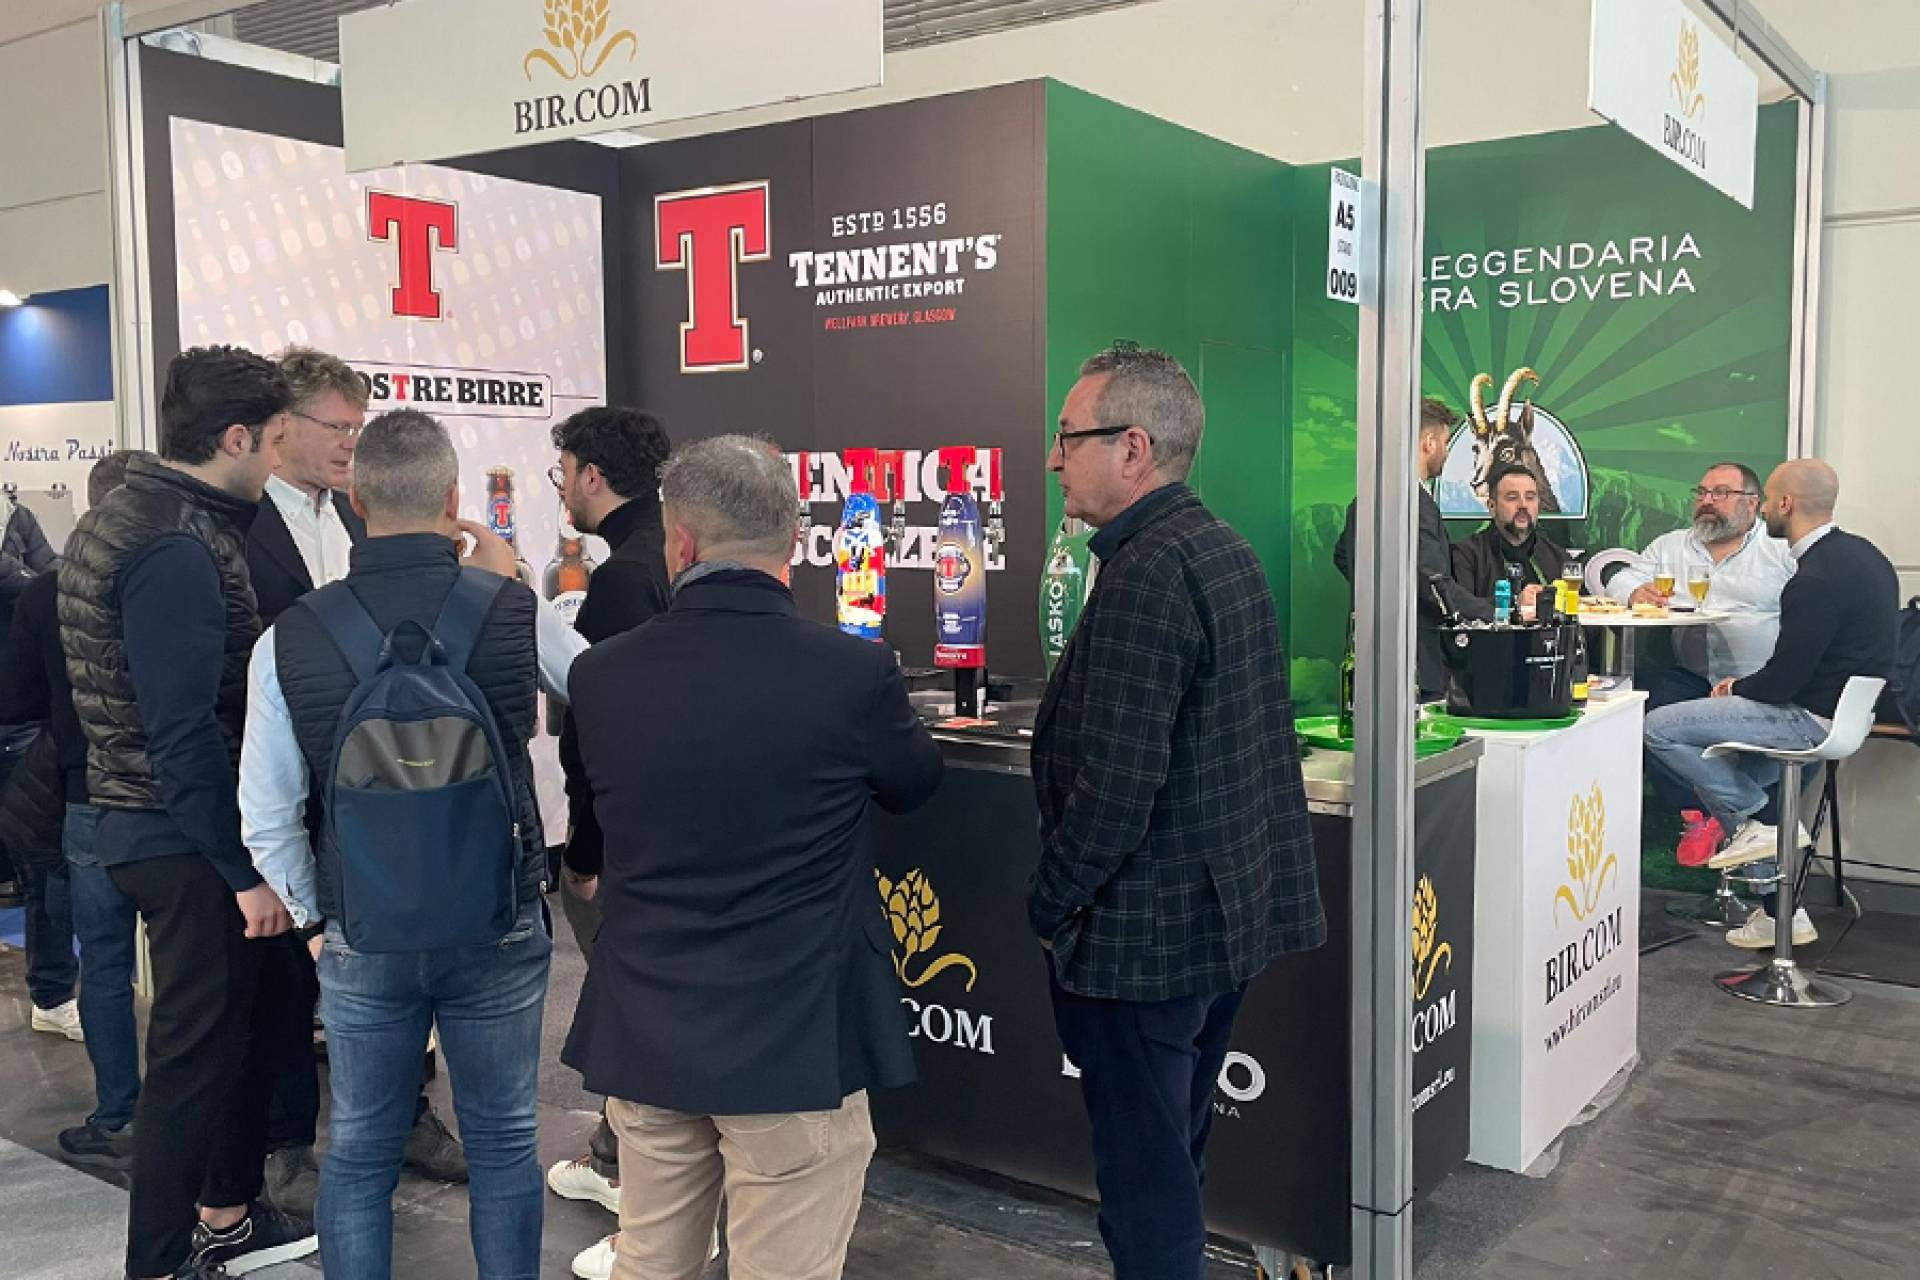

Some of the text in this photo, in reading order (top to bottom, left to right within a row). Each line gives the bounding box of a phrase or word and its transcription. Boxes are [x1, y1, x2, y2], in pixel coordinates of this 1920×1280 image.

[514, 77, 652, 134] BIR.COM
[892, 202, 946, 229] 1556
[1335, 199, 1355, 231] A5
[365, 186, 460, 323] T
[655, 180, 770, 374] T
[788, 234, 1000, 287] TENNENT'S
[1422, 232, 1702, 283] EGGENDARIA
[816, 278, 965, 306] AUTHENTIC EXPORT
[1330, 266, 1357, 298] 009
[1499, 266, 1696, 308] SLOVENA
[356, 370, 543, 407] STRE BIRRE
[1544, 905, 1622, 1005] BIR.COM
[1412, 989, 1456, 1053] COM
